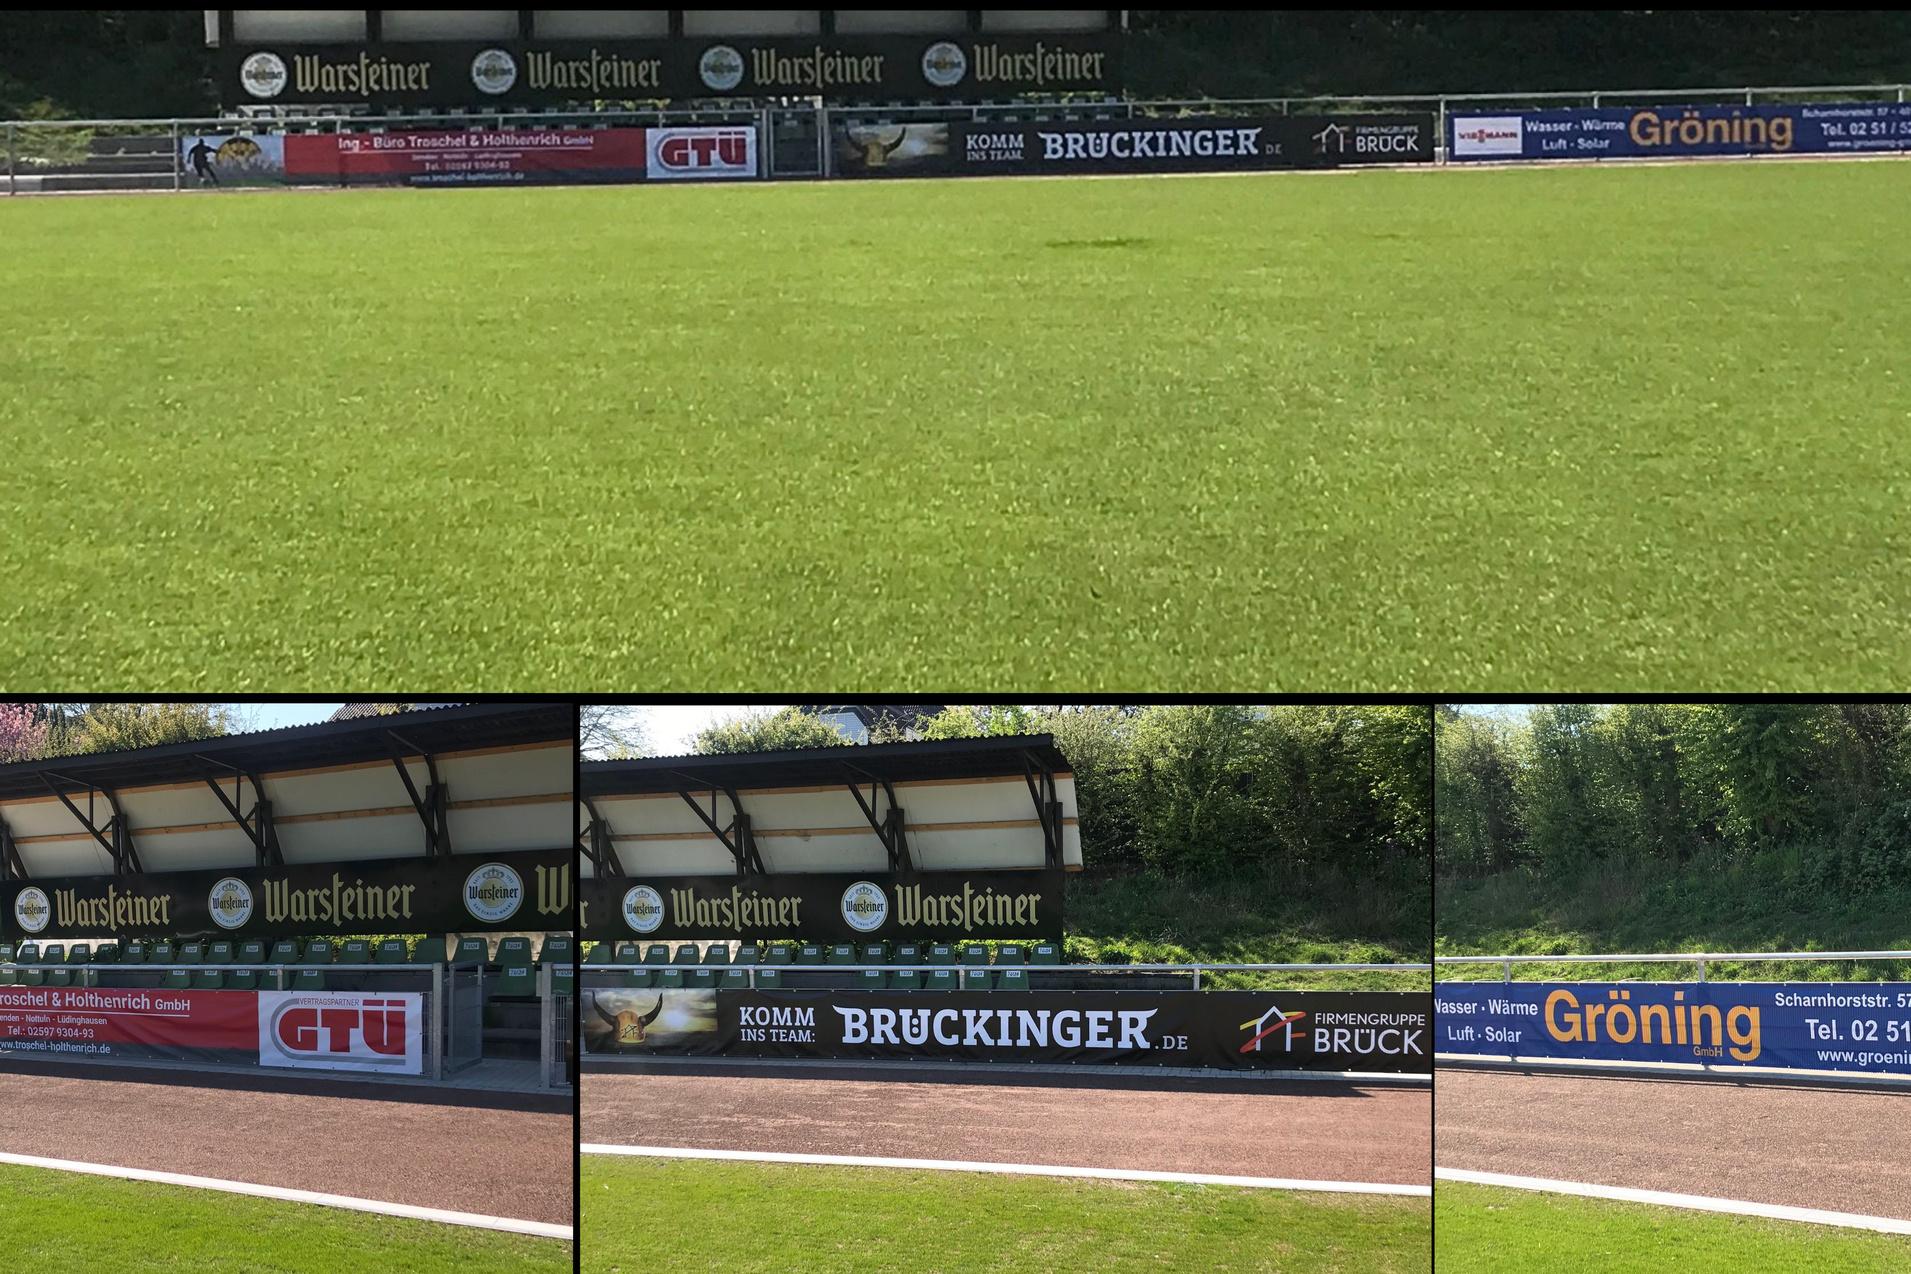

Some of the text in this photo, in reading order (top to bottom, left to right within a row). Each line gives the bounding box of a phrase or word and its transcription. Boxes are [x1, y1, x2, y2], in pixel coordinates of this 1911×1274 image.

[528, 48, 661, 94] Warsteiner
[753, 45, 884, 88] Warsteiner
[974, 42, 1104, 85] Warsteiner
[295, 51, 430, 96] Warsteiner
[1525, 119, 1625, 132] Wasser Wärme
[1629, 109, 1792, 151] Gröning
[1821, 123, 1846, 136] Tel.
[1849, 122, 1867, 135] 02
[1871, 121, 1886, 135] 51
[374, 136, 405, 148] Büro
[409, 135, 466, 148] Troschel
[470, 135, 480, 146] &
[483, 134, 560, 146] Holthenrich
[661, 131, 748, 167] GTÜ
[966, 134, 1024, 149] KOMM
[1356, 134, 1419, 152] BRÜCK
[1542, 138, 1609, 150] Luft Solar
[967, 150, 987, 161] INS
[262, 871, 416, 927] Warsteiner
[468, 883, 519, 901] Warsteiner
[18, 902, 48, 917] Warsteiner
[55, 884, 171, 932] Warsteiner
[212, 895, 250, 911] Warsteiner
[625, 902, 661, 916] Warsteiner
[671, 884, 803, 933] Warsteiner
[845, 899, 884, 914] Warsteiner
[895, 881, 1042, 932] Warsteiner
[52, 992, 62, 1007] &
[65, 993, 151, 1010] Holthenrich
[155, 999, 191, 1011] GmbH
[300, 998, 360, 1007] VERTRAGSPARTNER
[1488, 999, 1538, 1016] Wärme
[1775, 992, 1891, 1007] Scharnhorststr.
[25, 1014, 51, 1023] Nottuln
[57, 1015, 108, 1026] Lüdinghausen
[739, 1006, 815, 1027] KOMM
[1315, 1013, 1426, 1026] FIRMENGRUPPE
[8, 1026, 94, 1038] Tel.: 02597 9304-93
[279, 999, 406, 1055] GTÜ
[1448, 1026, 1522, 1042] Luft Solar
[1544, 989, 1761, 1062] Gröning
[1805, 1019, 1911, 1042] Tel. 02 51
[741, 1028, 816, 1043] INS TEAM:
[1314, 1028, 1424, 1055] BRÜCK
[0, 1040, 111, 1054] ww.troschel-holthenrich.de
[1693, 1046, 1723, 1057] GmbH
[1817, 1050, 1911, 1067] www.groeni
